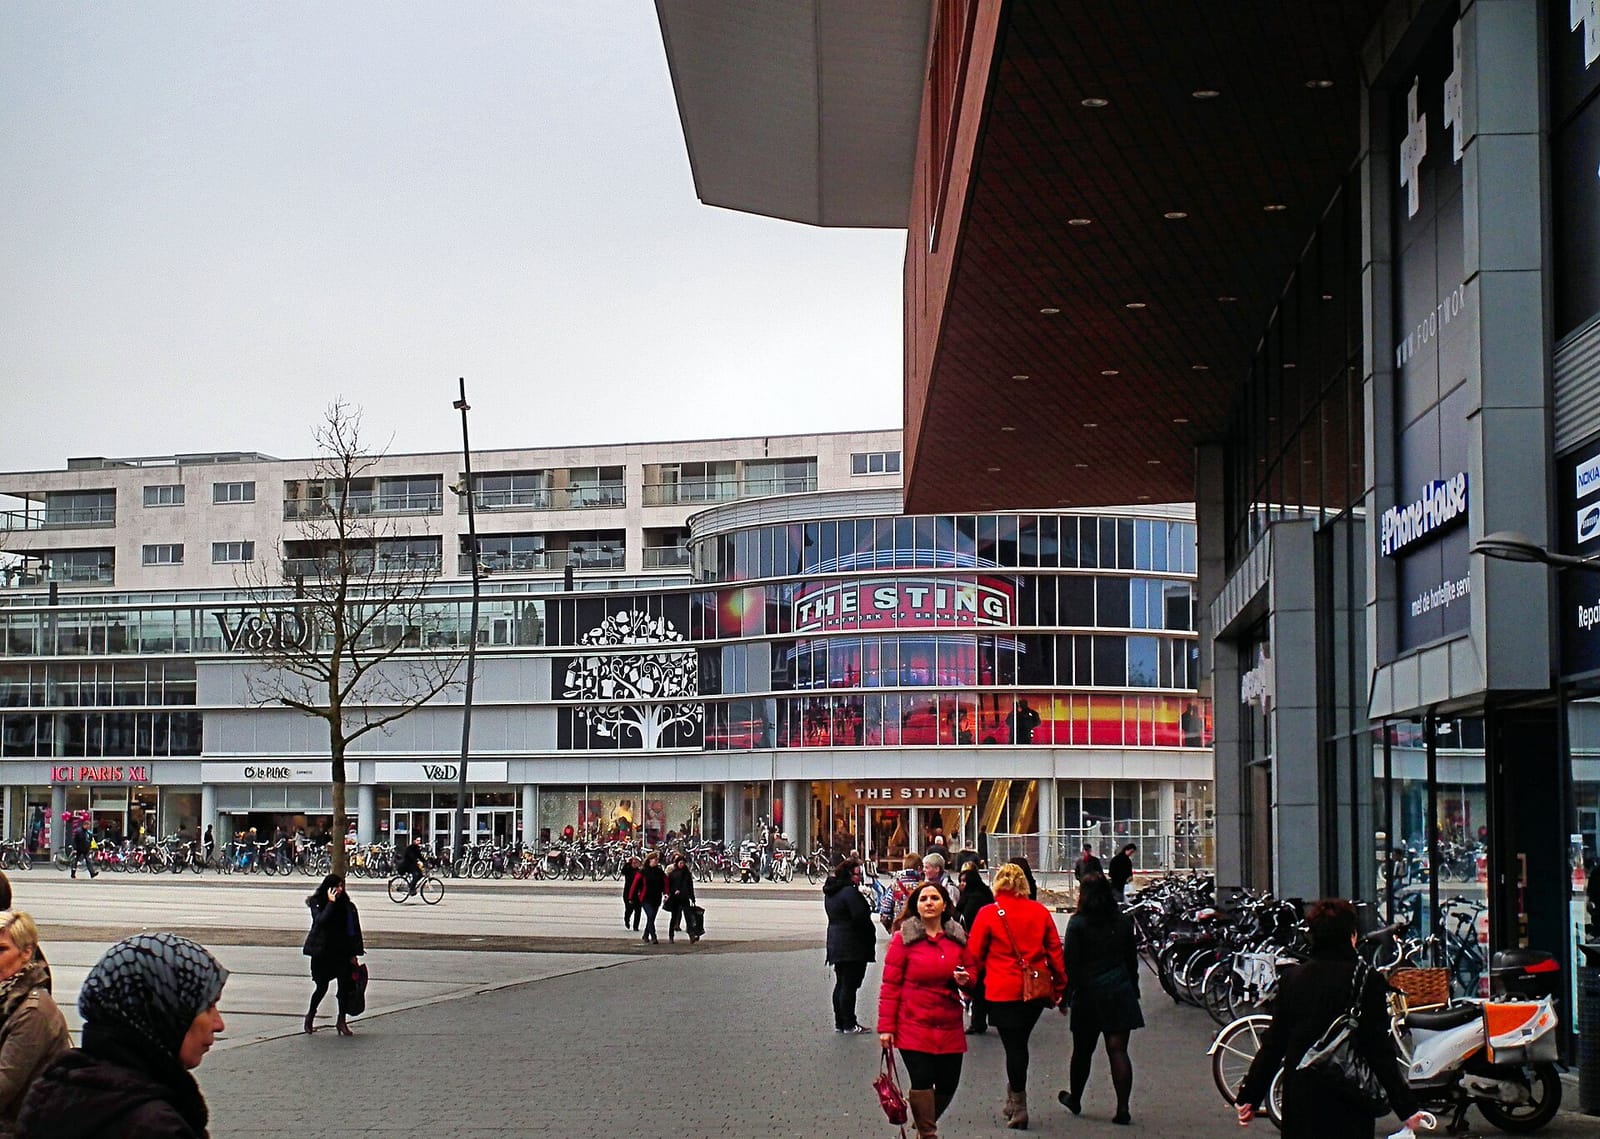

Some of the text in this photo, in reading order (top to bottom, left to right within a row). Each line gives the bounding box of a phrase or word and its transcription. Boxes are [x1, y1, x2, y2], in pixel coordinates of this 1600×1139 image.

[1579, 466, 1600, 487] NOKIA
[800, 586, 1003, 623] THE STING
[1423, 591, 1430, 612] de
[827, 613, 882, 626] NETWORK
[211, 610, 308, 651] V&D
[51, 766, 148, 782] ICI PARIS XL
[422, 764, 458, 780] V&D
[855, 787, 967, 799] THE STING
